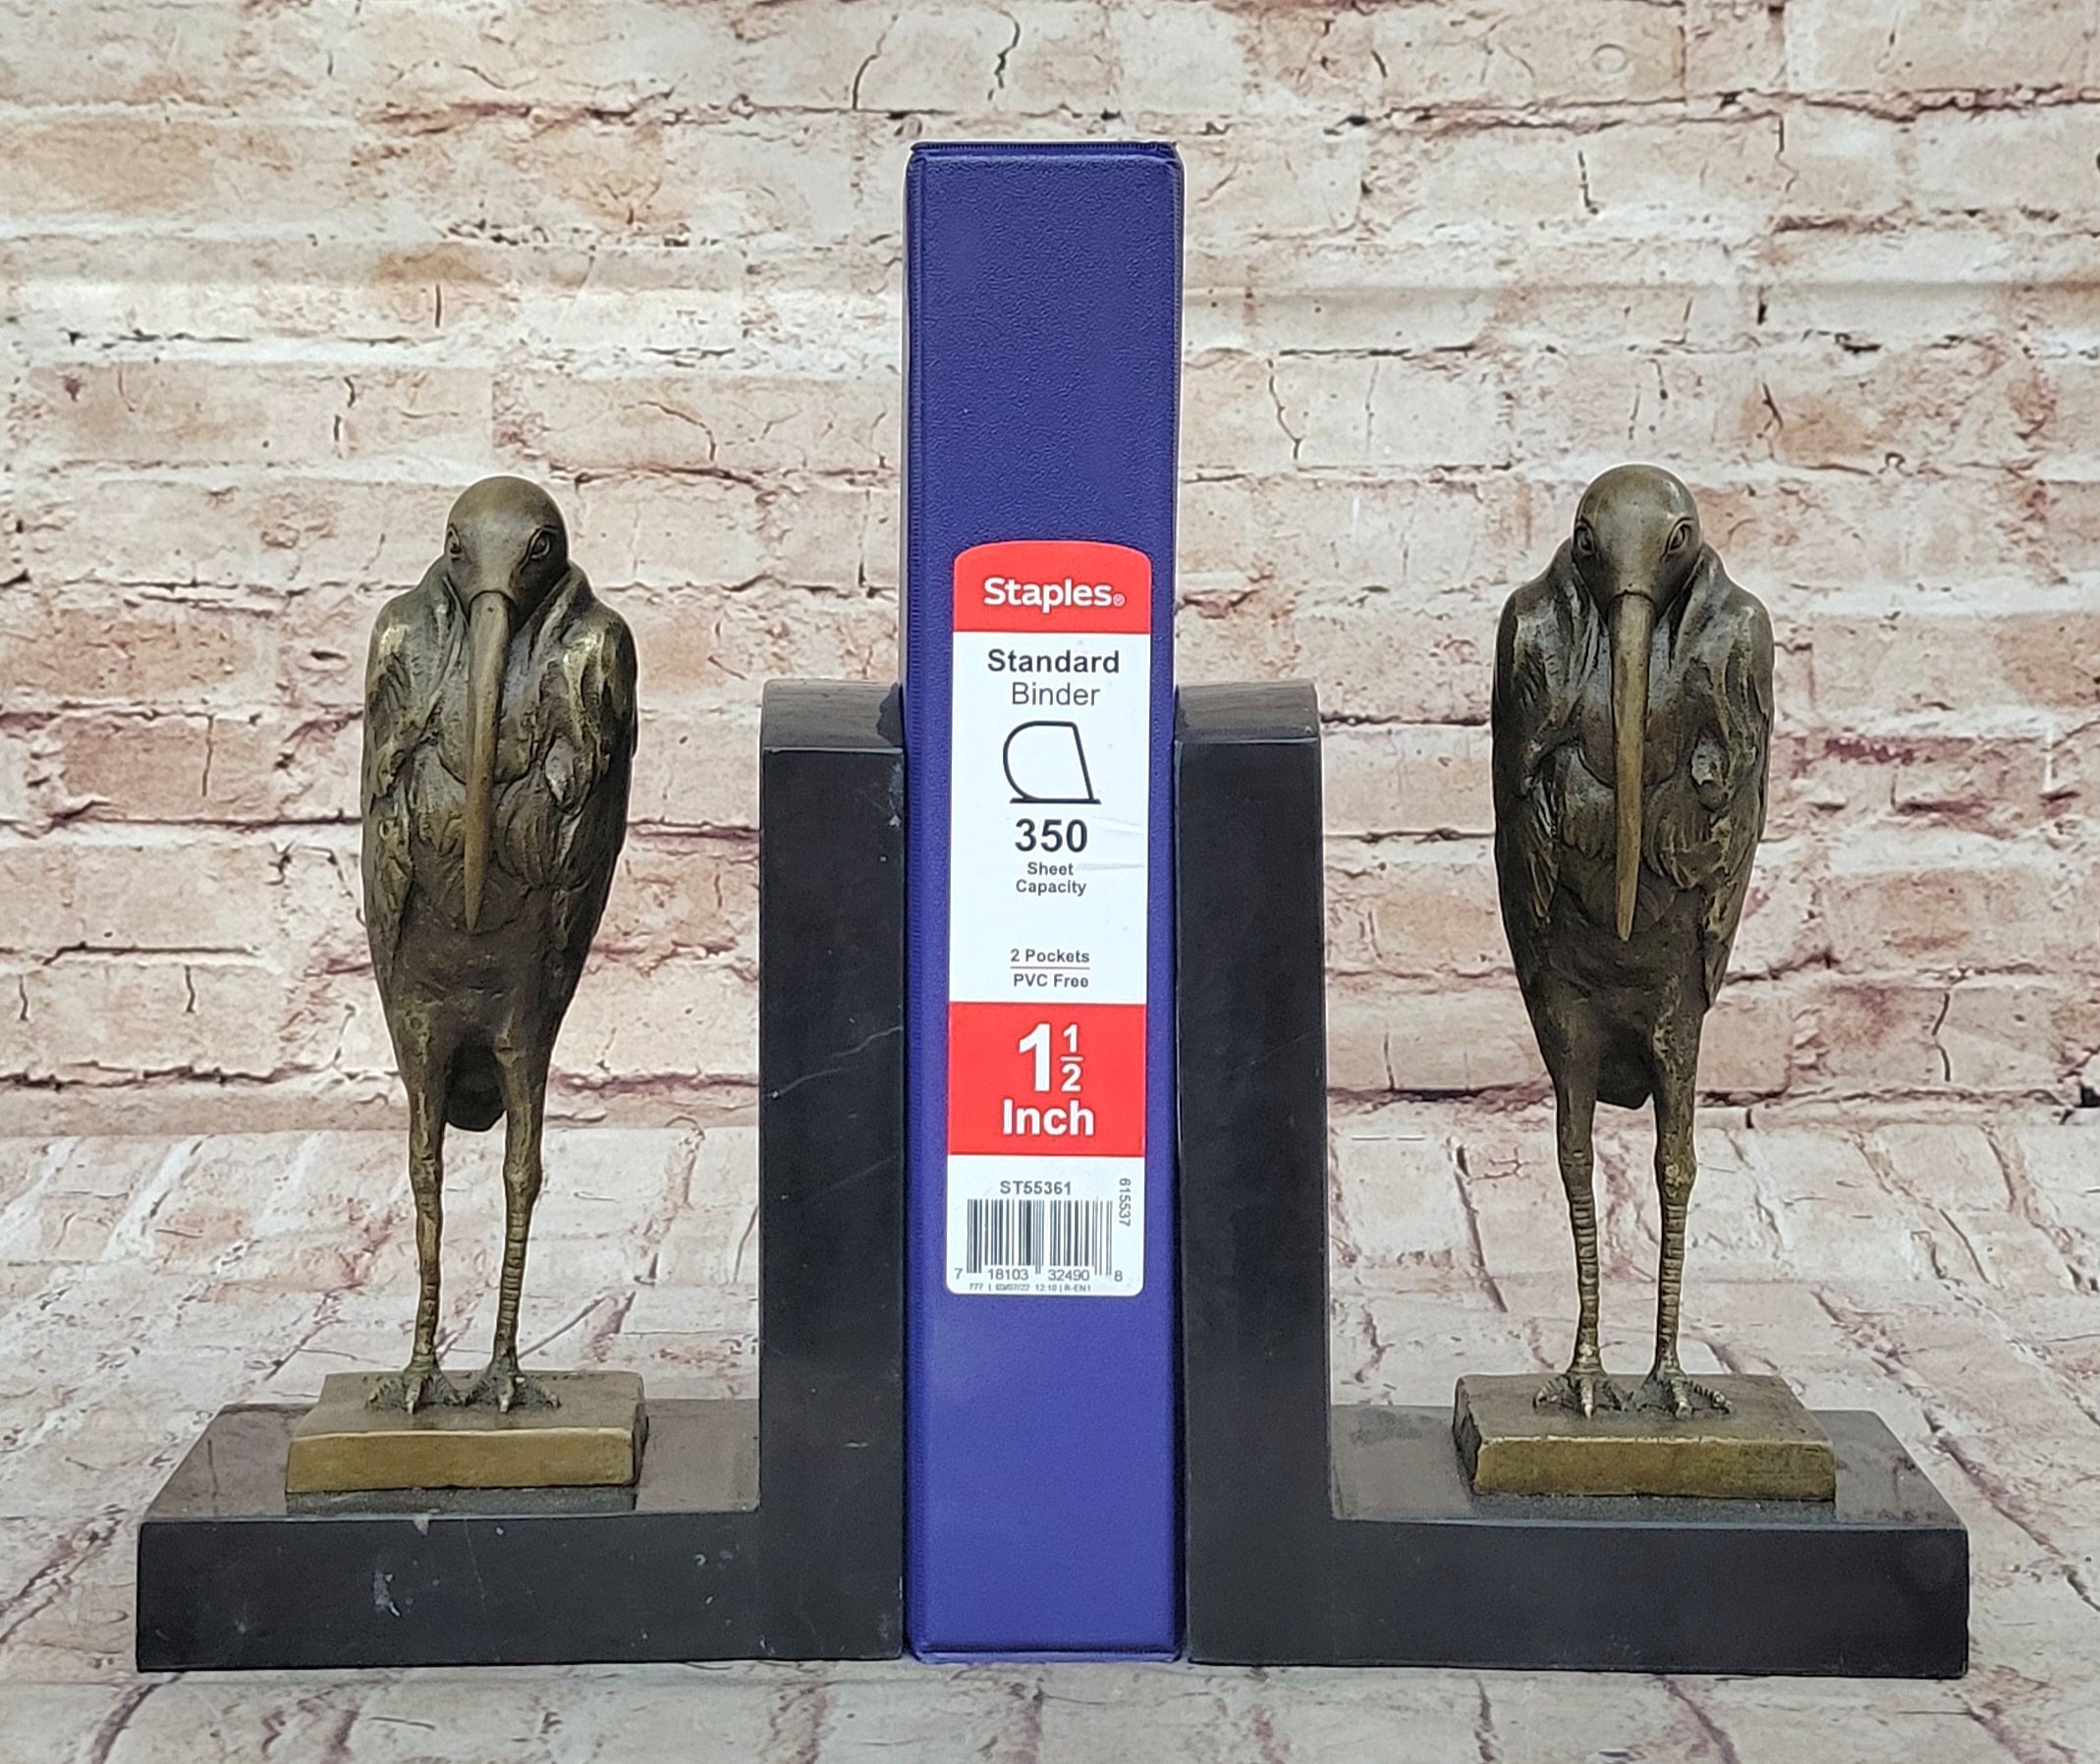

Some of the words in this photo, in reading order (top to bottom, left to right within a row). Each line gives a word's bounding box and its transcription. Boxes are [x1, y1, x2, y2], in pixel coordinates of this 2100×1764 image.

[983, 577, 1113, 613] Staples
[987, 648, 1120, 673] Standard
[1012, 682, 1100, 706] Binder
[1015, 818, 1088, 853] 350
[1026, 861, 1074, 876] Sheet
[1016, 879, 1086, 897] Capacity
[1010, 949, 1021, 963] 2
[1024, 949, 1090, 964] Pockets
[1013, 973, 1048, 987] PVC
[1053, 974, 1089, 988] Free
[1019, 1023, 1051, 1092] 1
[1002, 1099, 1094, 1136] Inch
[999, 1181, 1072, 1195] ST55361
[1119, 1178, 1132, 1227] 615537
[954, 1268, 964, 1280] 7
[988, 1269, 1029, 1281] 18103
[1048, 1269, 1090, 1282] 32490
[1114, 1270, 1123, 1282] 8
